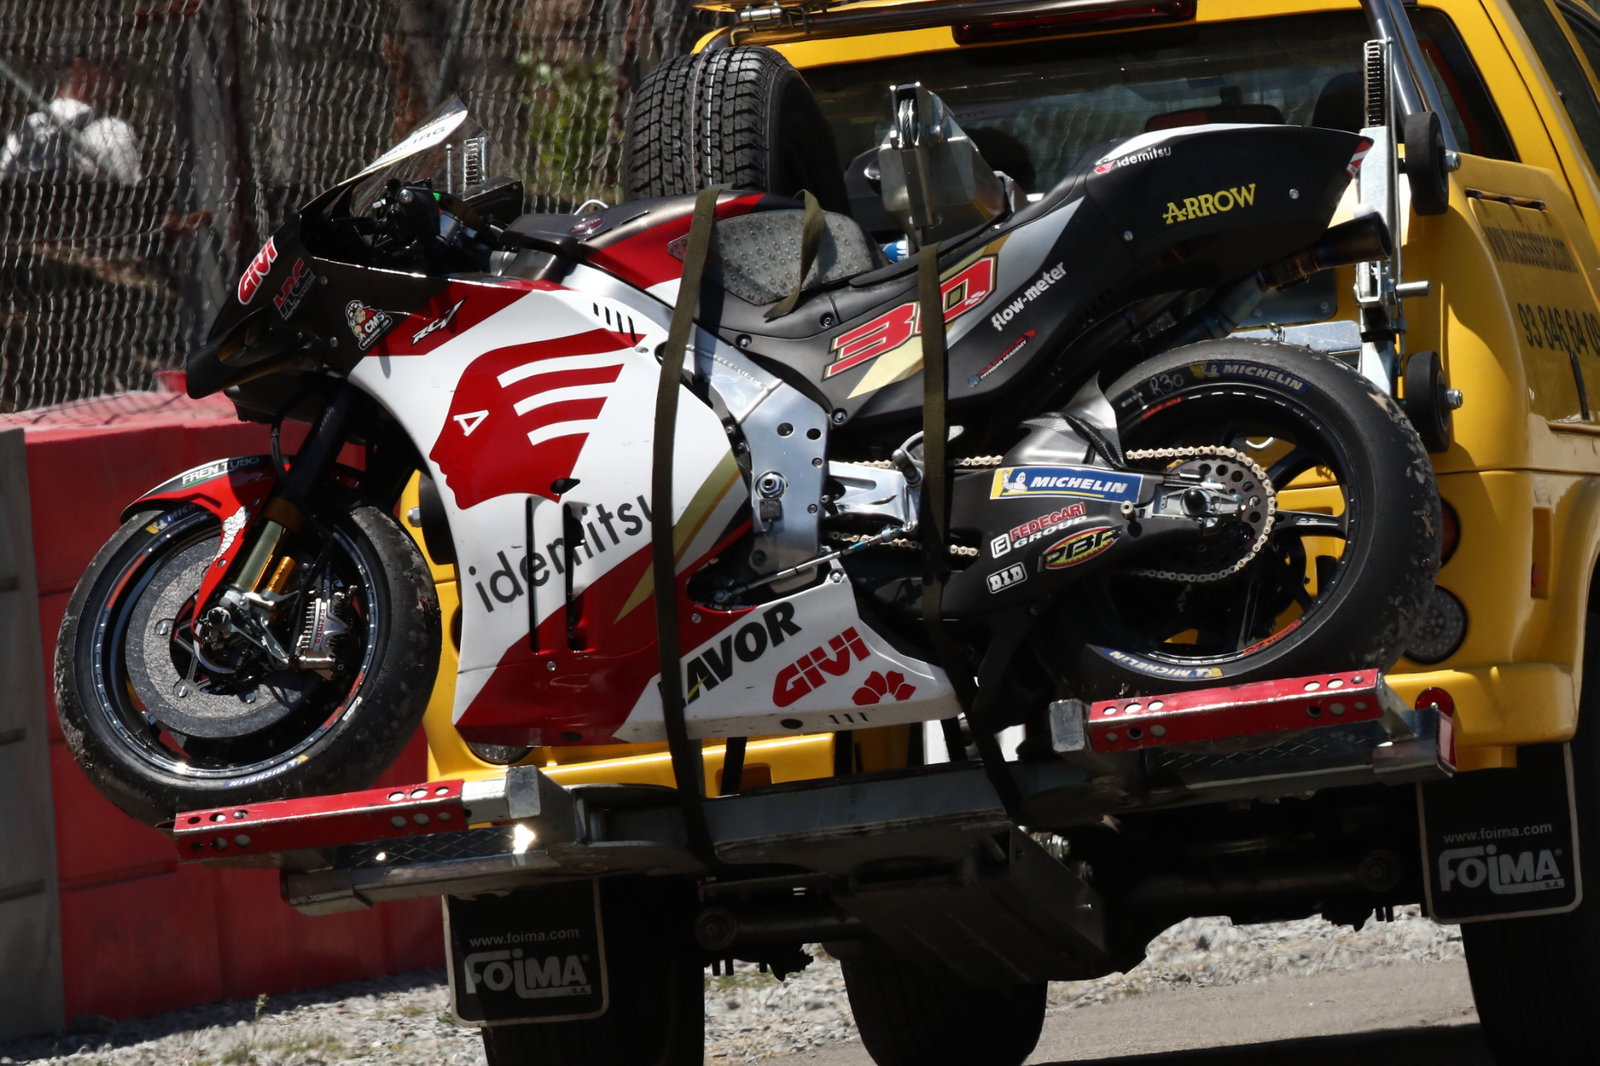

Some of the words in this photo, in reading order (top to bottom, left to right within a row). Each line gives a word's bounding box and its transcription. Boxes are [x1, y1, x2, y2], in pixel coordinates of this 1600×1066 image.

[1116, 146, 1172, 168] idemitsu
[1162, 183, 1256, 224] ARROW
[991, 261, 1068, 332] flow-meter
[364, 312, 385, 334] CMS
[820, 252, 999, 383] 30
[1222, 363, 1304, 392] MICHELIN
[1030, 476, 1128, 494] MICHELIN
[1010, 501, 1088, 541] FEDEGARI
[1013, 515, 1088, 550] GROUP
[658, 600, 803, 708] AVOR
[772, 625, 872, 708] GIVI
[1109, 650, 1194, 678] MICHELIN
[1443, 822, 1553, 844] www.foima.com
[469, 927, 580, 948] www.foima.com
